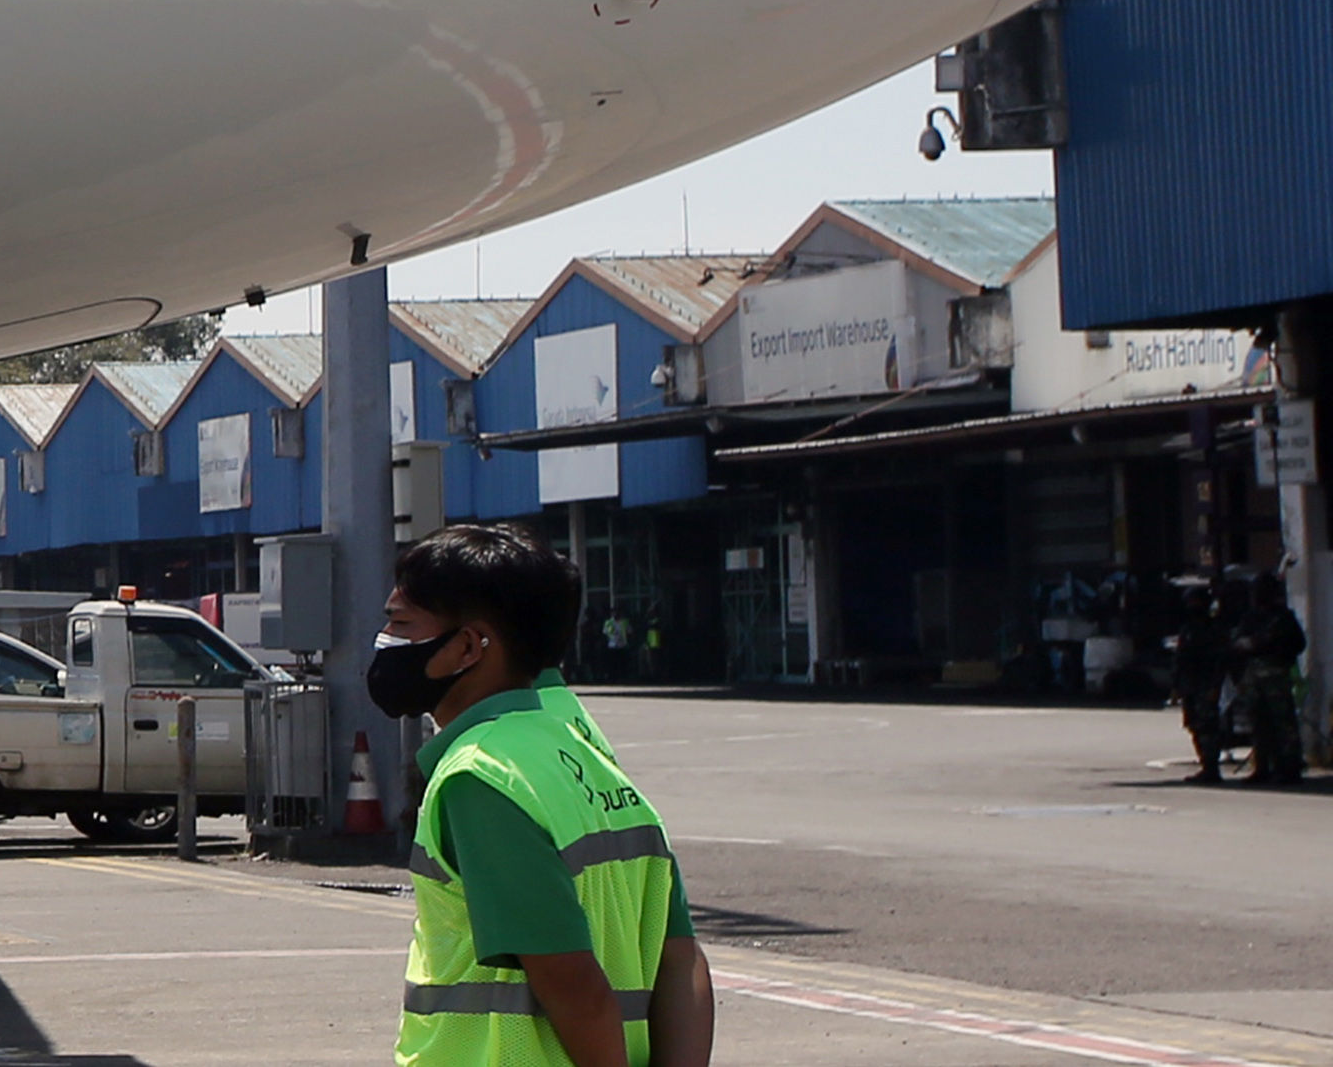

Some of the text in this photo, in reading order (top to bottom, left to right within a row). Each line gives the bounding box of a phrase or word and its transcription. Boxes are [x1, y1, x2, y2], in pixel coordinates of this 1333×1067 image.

[751, 315, 889, 363] Export Import Warehouse
[1126, 328, 1236, 373] Rush Handling
